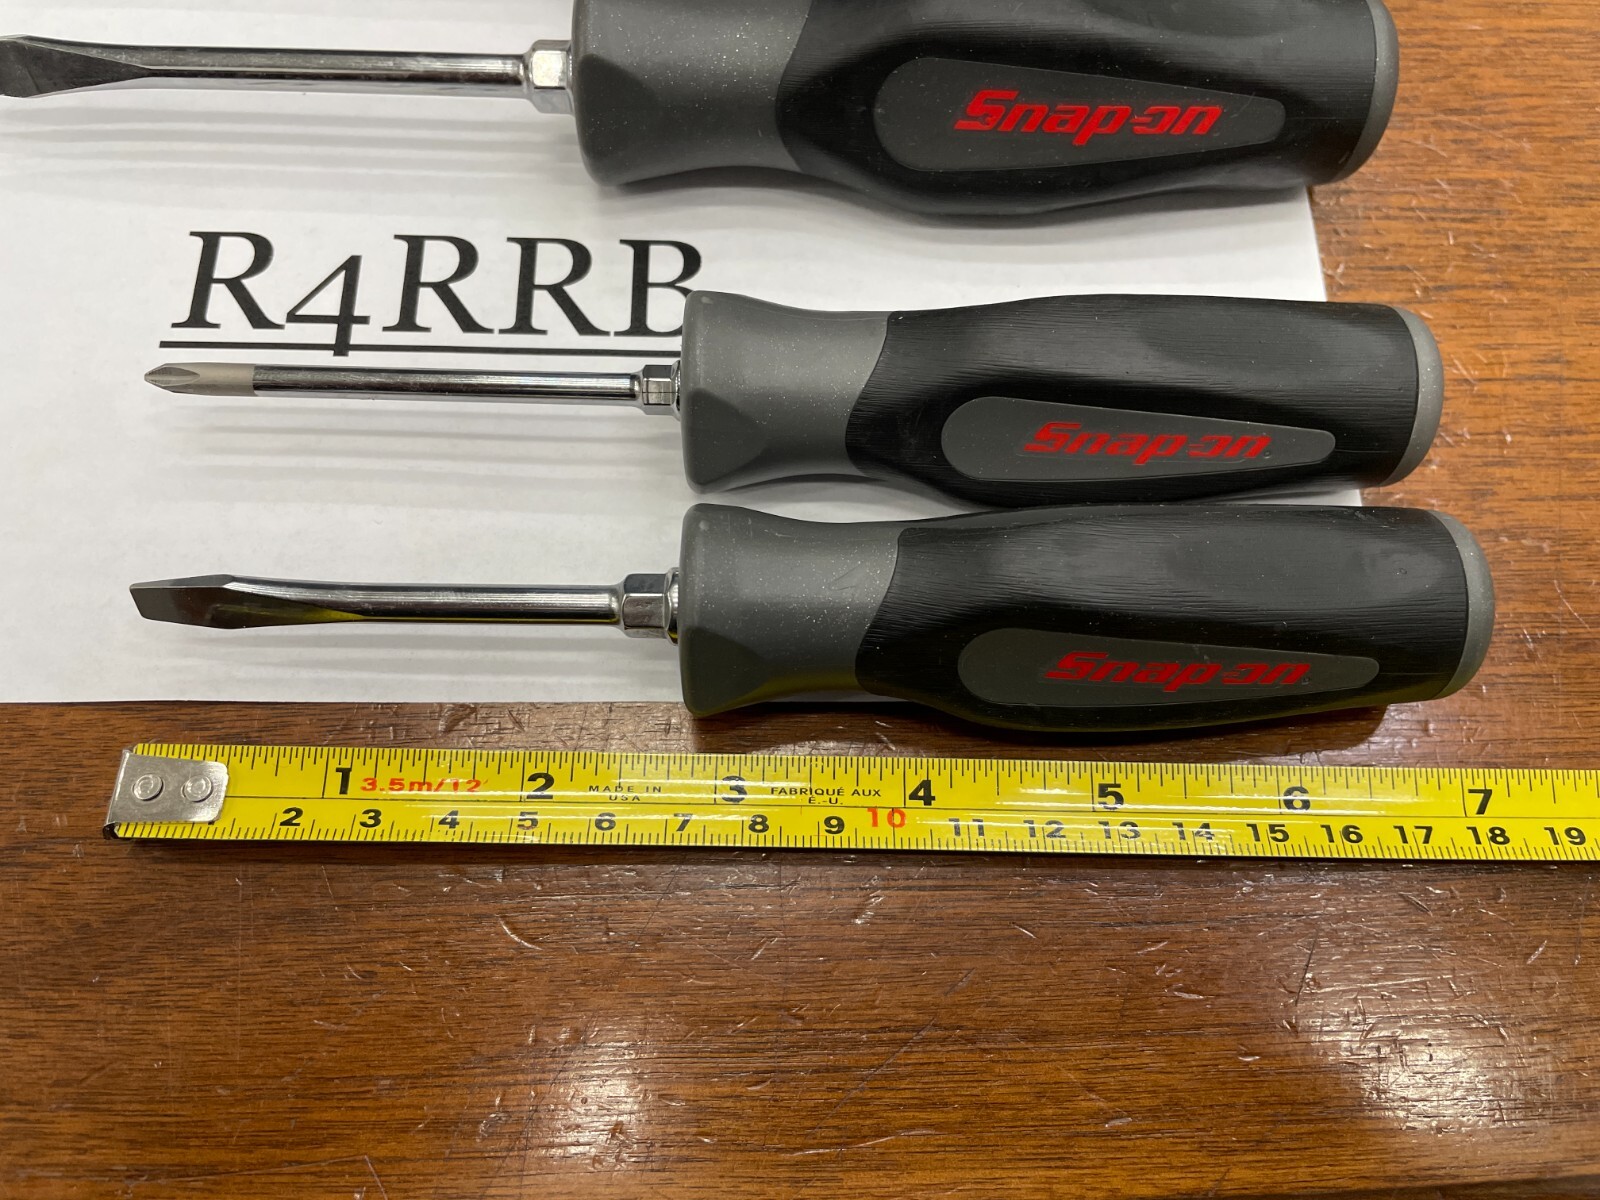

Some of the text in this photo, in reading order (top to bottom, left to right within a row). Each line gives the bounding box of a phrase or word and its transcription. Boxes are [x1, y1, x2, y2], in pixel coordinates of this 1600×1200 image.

[954, 89, 1223, 146] Snap-on
[171, 231, 702, 356] R4RRB
[1024, 422, 1272, 466] Snap-on
[1044, 651, 1311, 693] Snap-on
[335, 767, 353, 795] 1
[526, 773, 556, 800] 2
[721, 775, 748, 803] 3
[908, 779, 936, 807] 4
[1098, 783, 1125, 811] 5
[1283, 786, 1311, 813] 6
[1467, 788, 1494, 816] 7
[588, 785, 662, 793] MADE IN
[608, 794, 641, 802] USA
[770, 786, 882, 797] FABRIQUÉ AUX
[279, 807, 1587, 846] 2 3 4 5 6 7 8 9 10 11 12 13 14 15 16 17 18 19
